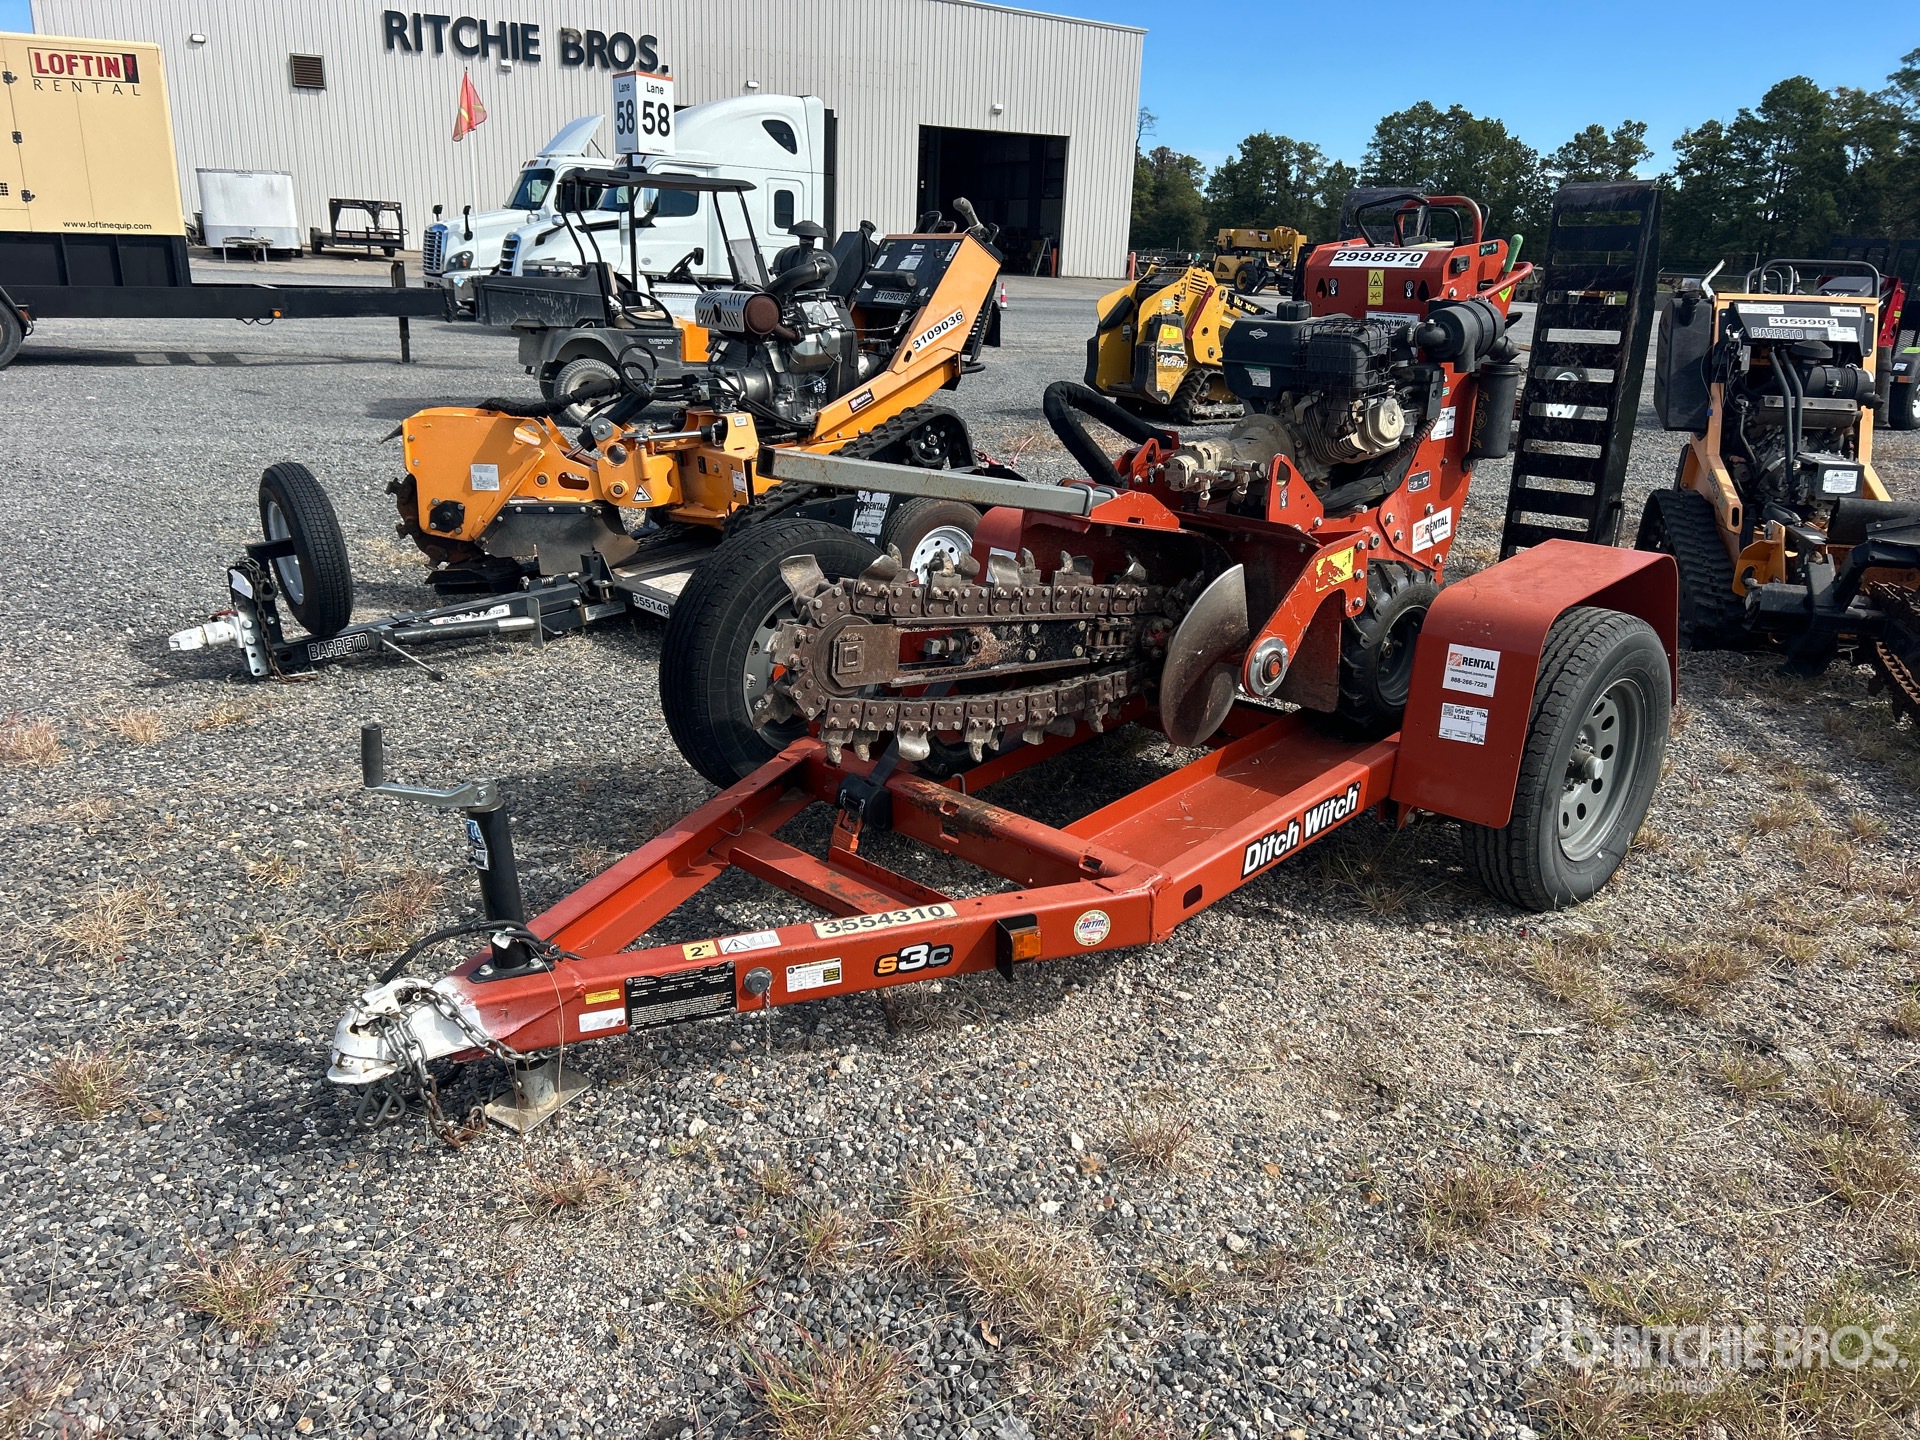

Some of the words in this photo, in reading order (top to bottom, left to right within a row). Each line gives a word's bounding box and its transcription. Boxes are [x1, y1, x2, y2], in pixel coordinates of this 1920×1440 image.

[384, 9, 541, 62] RITCHIE
[560, 26, 669, 74] BROS.
[33, 51, 122, 79] LOFTIN
[33, 78, 142, 97] RENTAL
[618, 82, 631, 93] Lane
[646, 82, 665, 95] Lane
[616, 98, 636, 136] 58
[641, 100, 671, 138] 58
[62, 220, 153, 231] www.loftinequip.com
[1333, 251, 1424, 263] 2998870
[875, 291, 911, 301] 3109036
[912, 310, 964, 351] 3109036
[1770, 317, 1837, 327] 3059906
[1750, 326, 1804, 340] BARRETO
[1424, 515, 1449, 535] RENTAL
[307, 632, 370, 661] BARRETO
[1462, 656, 1496, 671] RENTAL
[1450, 676, 1488, 689] 888-266-7228
[1242, 820, 1301, 877] Ditch
[1304, 785, 1359, 840] Witch
[822, 905, 946, 934] 3554310
[690, 944, 709, 957] 2"
